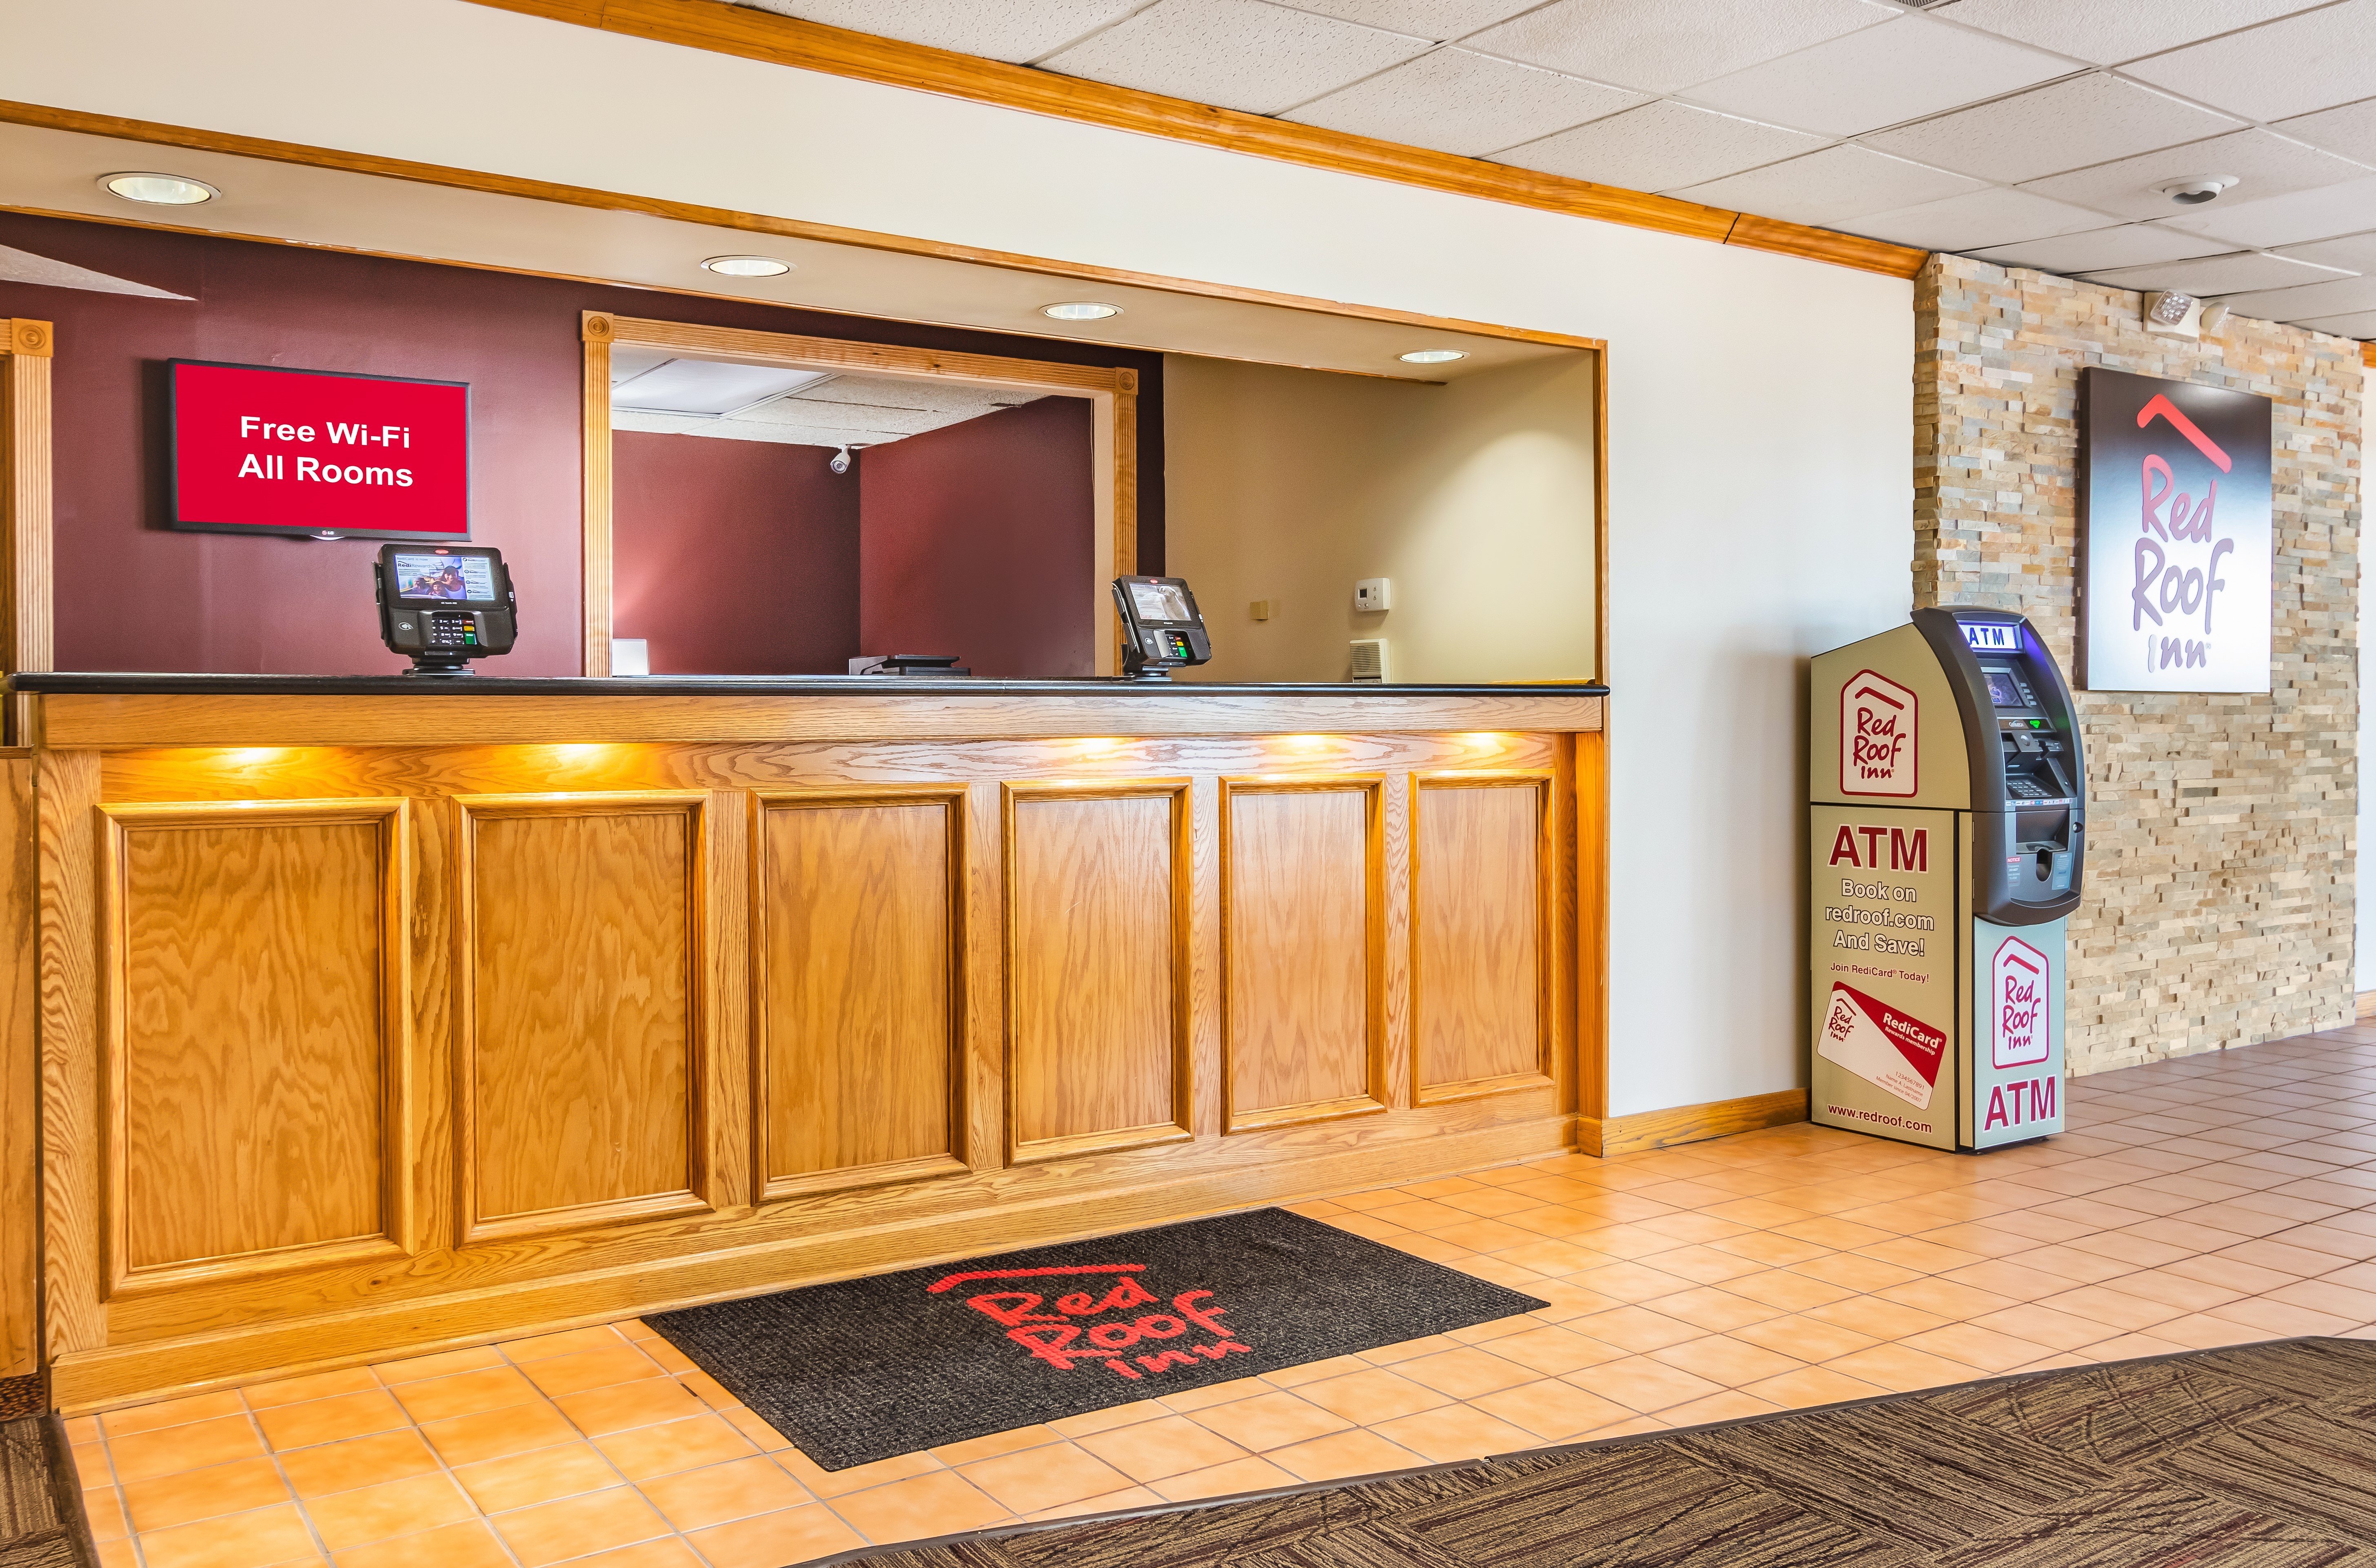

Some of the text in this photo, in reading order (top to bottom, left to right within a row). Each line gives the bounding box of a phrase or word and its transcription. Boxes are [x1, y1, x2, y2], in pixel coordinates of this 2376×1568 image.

[241, 416, 410, 448] Free Wi-Fi
[238, 454, 413, 487] All Rooms
[2142, 454, 2217, 543] Red
[2132, 537, 2234, 634] Roof
[1970, 628, 2004, 645] ATM
[1857, 707, 1897, 737] Red
[1853, 733, 1906, 767] Roof
[1828, 825, 1928, 872] ATM
[1841, 878, 1917, 902] Book on
[1825, 905, 1934, 931] redroof.com
[1833, 930, 1924, 956] And Save!
[1830, 963, 1848, 972] Join
[1899, 970, 1929, 983] Today!
[2005, 975, 2034, 1004] Red
[1828, 1017, 1854, 1038] Roof
[1834, 1006, 1852, 1024] Red
[2002, 998, 2041, 1038] Roof
[1885, 1027, 1935, 1056] Rewards membership
[1876, 1076, 1893, 1088] Member
[1905, 1091, 1921, 1102] 04/2007
[1886, 1074, 1898, 1083] Name
[1903, 1083, 1923, 1097] Lastname
[1896, 1071, 1924, 1089] 1234567891
[1984, 1076, 2056, 1131] ATM
[1828, 1104, 1932, 1133] www.redroof.com
[967, 1276, 1159, 1327] Red
[1007, 1289, 1234, 1370] Roof
